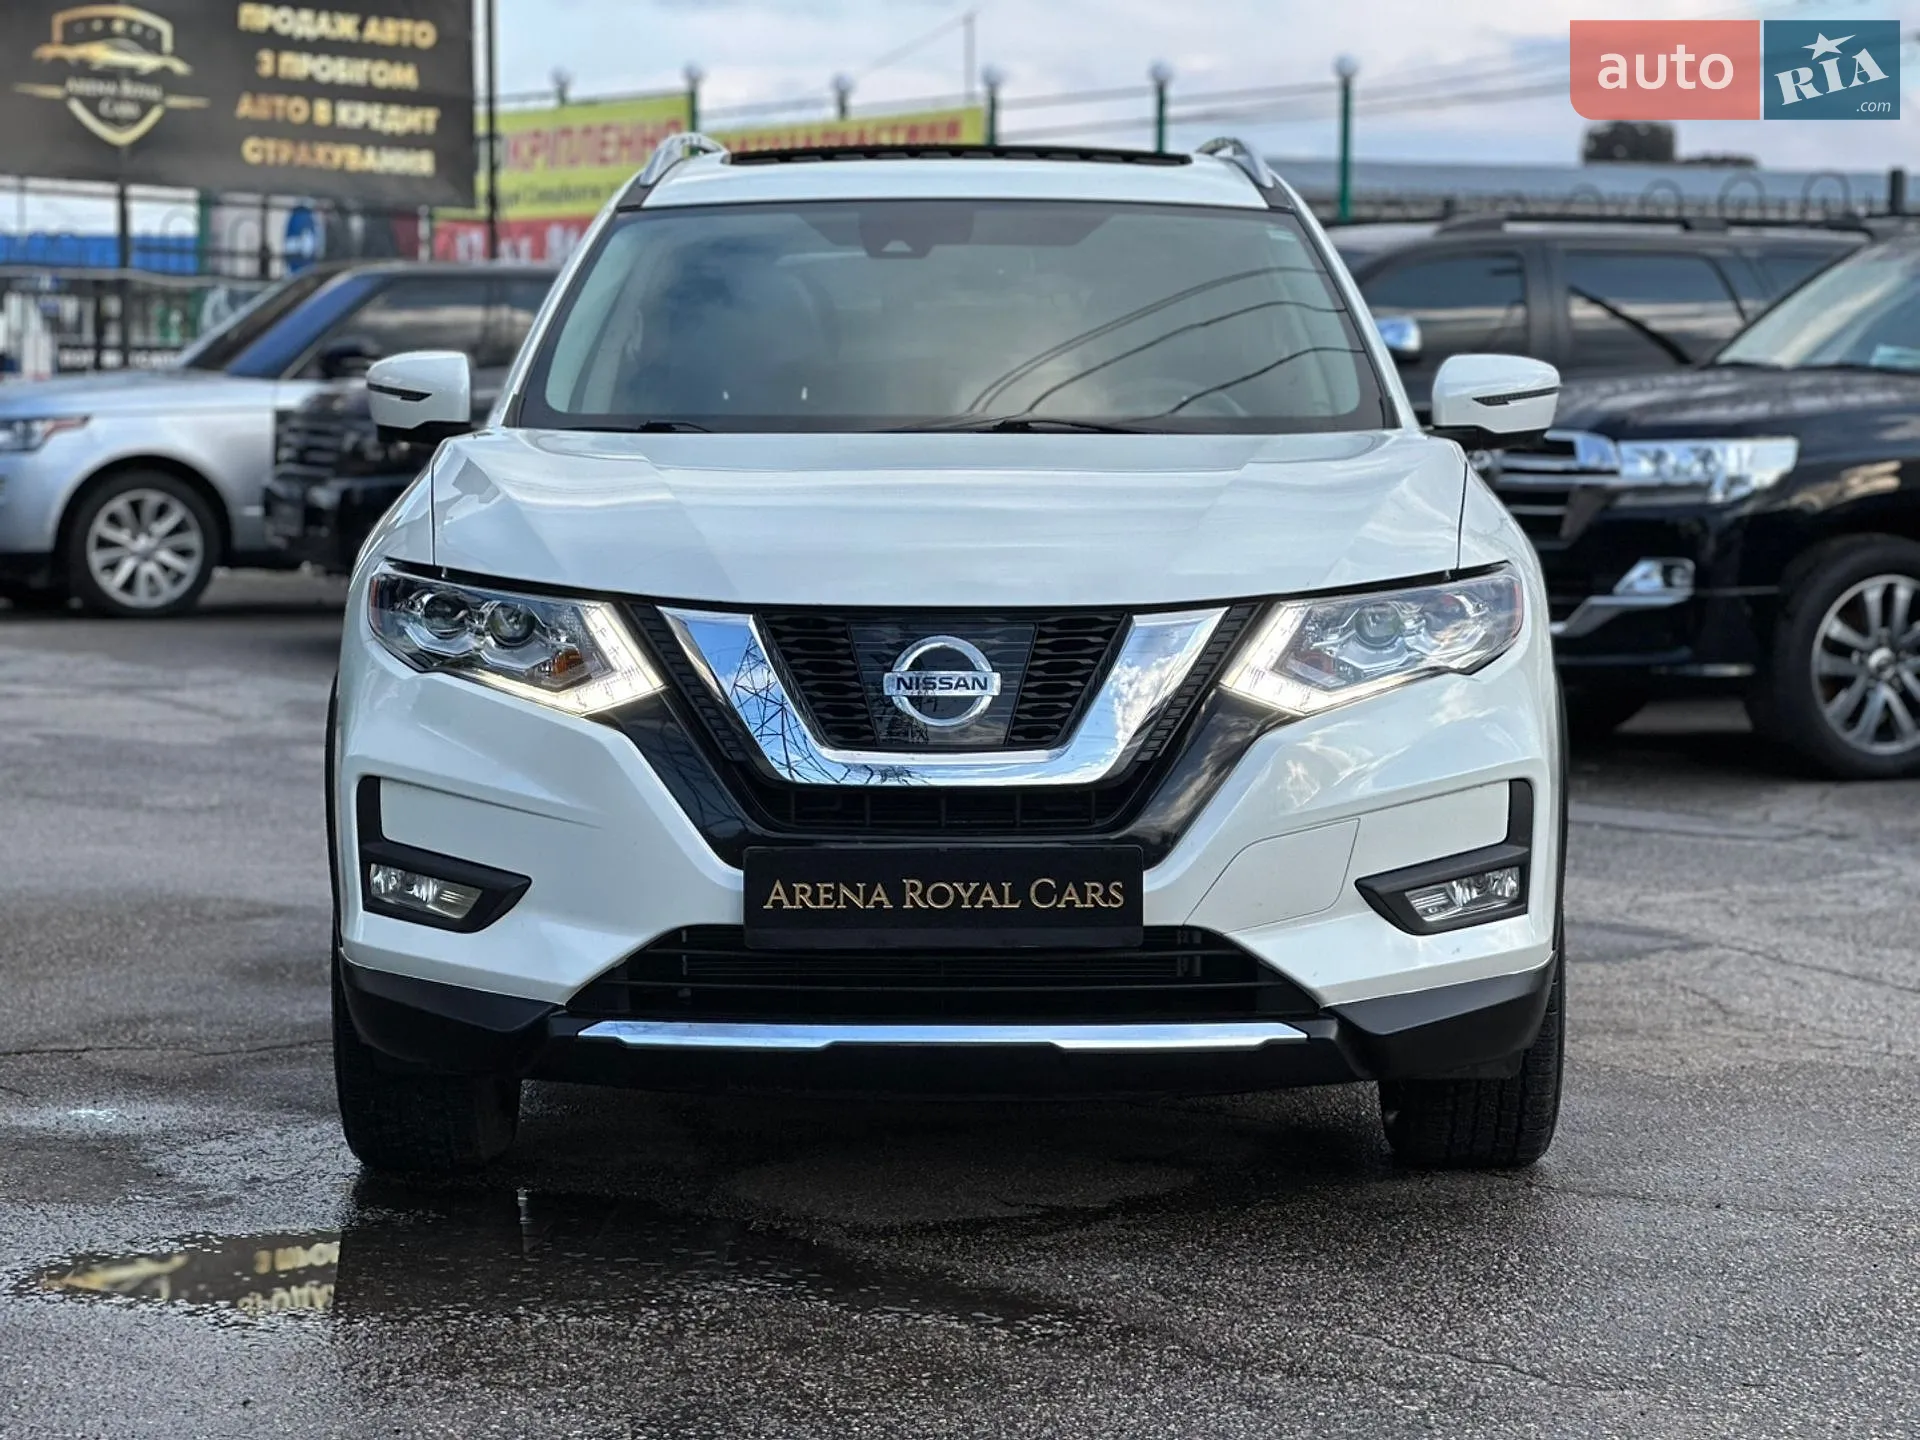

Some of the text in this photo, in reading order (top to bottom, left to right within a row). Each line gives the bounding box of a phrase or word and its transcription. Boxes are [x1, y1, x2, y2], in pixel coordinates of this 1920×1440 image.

[237, 2, 438, 49] ПРОДАЖ АВТО
[277, 51, 420, 91] ПРОБІГОМ
[235, 91, 442, 136] АВТО В КРЕДИТ
[241, 135, 437, 177] СТРАХУВАННЯ
[896, 676, 988, 691] NISSAN
[763, 878, 1124, 910] ARENA ROYAL CARS
